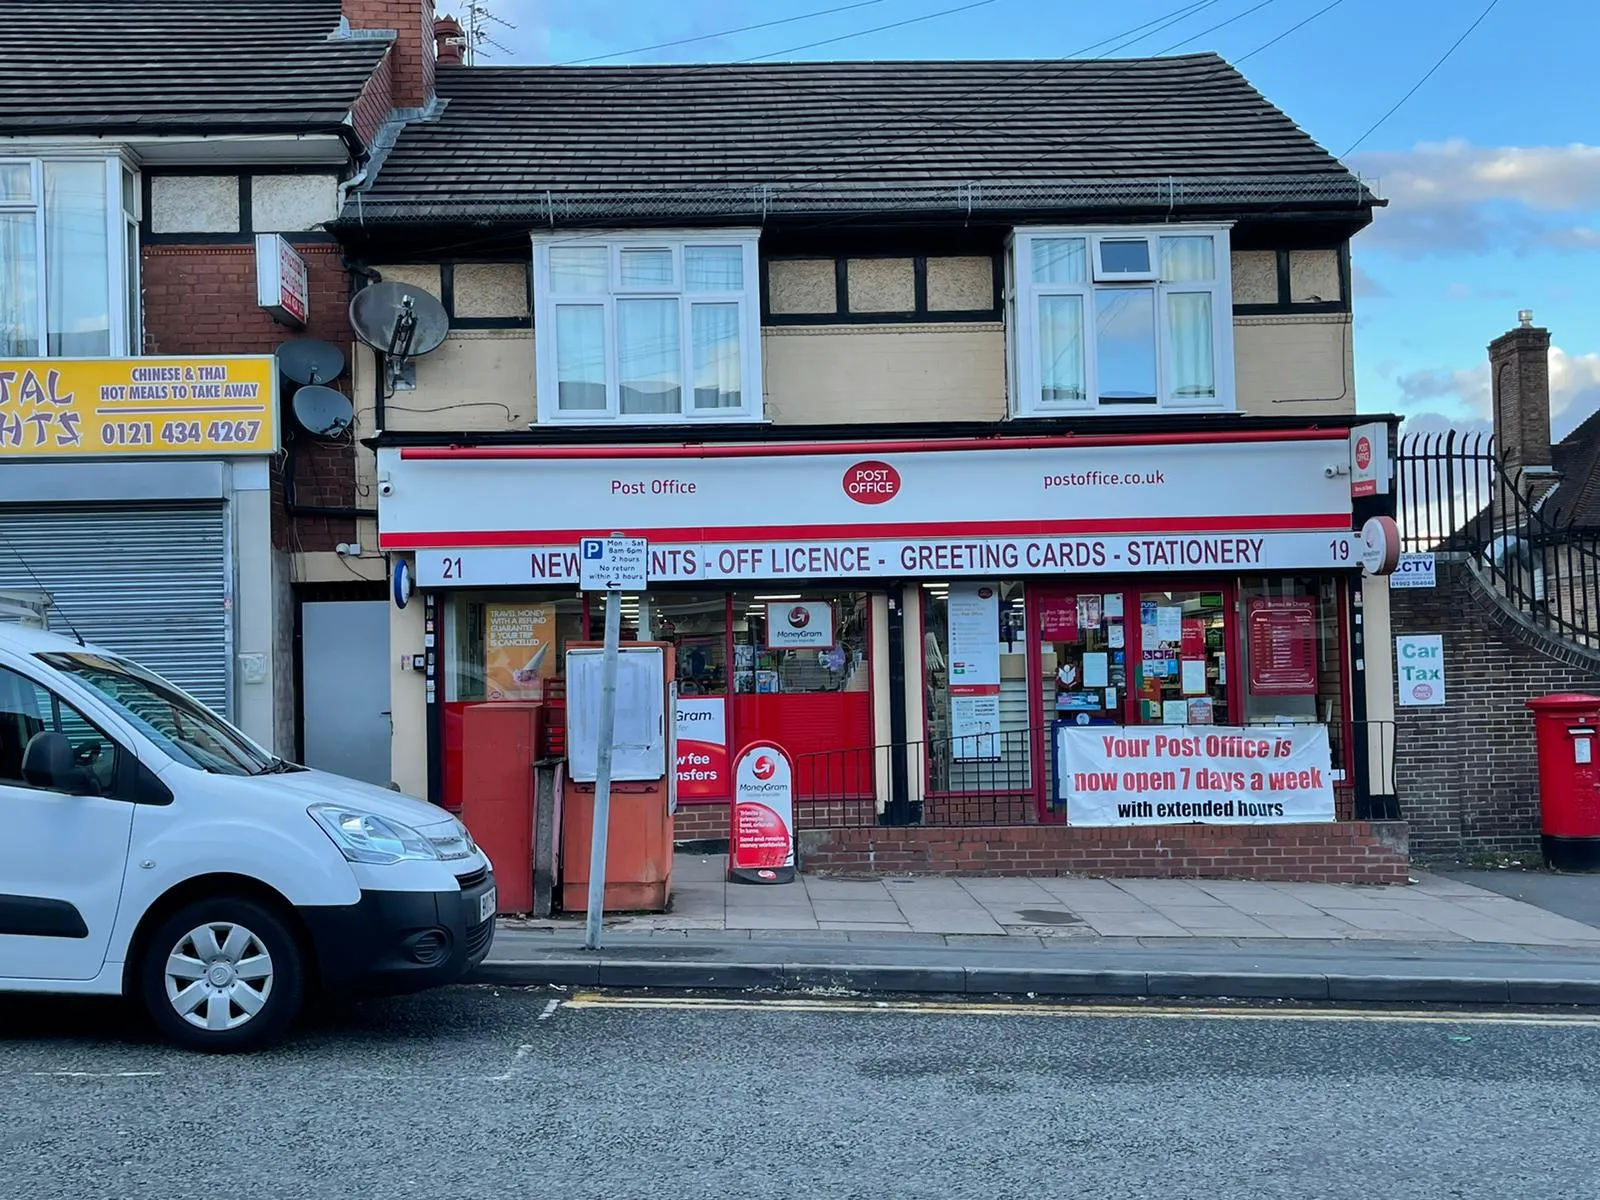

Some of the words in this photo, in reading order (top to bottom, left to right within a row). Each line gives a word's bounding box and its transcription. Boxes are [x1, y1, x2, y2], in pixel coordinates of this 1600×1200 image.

[132, 367, 183, 382] CHINESE
[185, 367, 195, 381] &
[198, 366, 226, 381] THAI
[101, 386, 126, 401] HOT
[129, 386, 168, 400] MEALS
[171, 385, 188, 399] TO
[191, 385, 221, 399] TAKE
[224, 384, 259, 398] AWAY
[102, 423, 151, 445] 0121
[161, 422, 201, 444] 434
[207, 421, 261, 443] 4267
[1358, 442, 1368, 452] POST
[1357, 452, 1370, 462] OFFICE
[856, 470, 889, 481] POST
[1043, 469, 1165, 489] postoffice.co.uk
[611, 480, 646, 494] Post
[651, 479, 697, 494] Office
[848, 482, 893, 494] OFFICE
[718, 548, 764, 574] OFF
[772, 547, 871, 573] LICENCE
[900, 543, 1019, 571] GREETING
[1026, 541, 1106, 568] CARDS
[1127, 539, 1264, 566] STATIONERY
[1329, 540, 1349, 561] 19
[442, 557, 463, 579] 21
[491, 609, 515, 617] TRAVEL
[518, 609, 545, 617] MONEY
[491, 617, 511, 625] WITH
[512, 617, 518, 625] A
[519, 617, 547, 625] REFUND
[777, 630, 822, 639] MoneyGram
[498, 639, 540, 647] CANCELLED
[1401, 643, 1439, 659] Car
[1401, 665, 1441, 681] Tax
[1102, 736, 1150, 758] Your
[1155, 735, 1201, 757] Post
[1206, 735, 1270, 758] Office
[1273, 737, 1292, 758] is
[688, 752, 710, 765] fee
[739, 783, 788, 792] MoneyGram
[1074, 772, 1118, 791] now
[1123, 770, 1176, 793] open
[1180, 767, 1191, 790] 7
[1196, 768, 1246, 792] days
[1250, 773, 1264, 790] a
[1268, 766, 1324, 790] week
[1118, 801, 1152, 818] with
[1157, 800, 1235, 818] extended
[1238, 799, 1284, 817] hours
